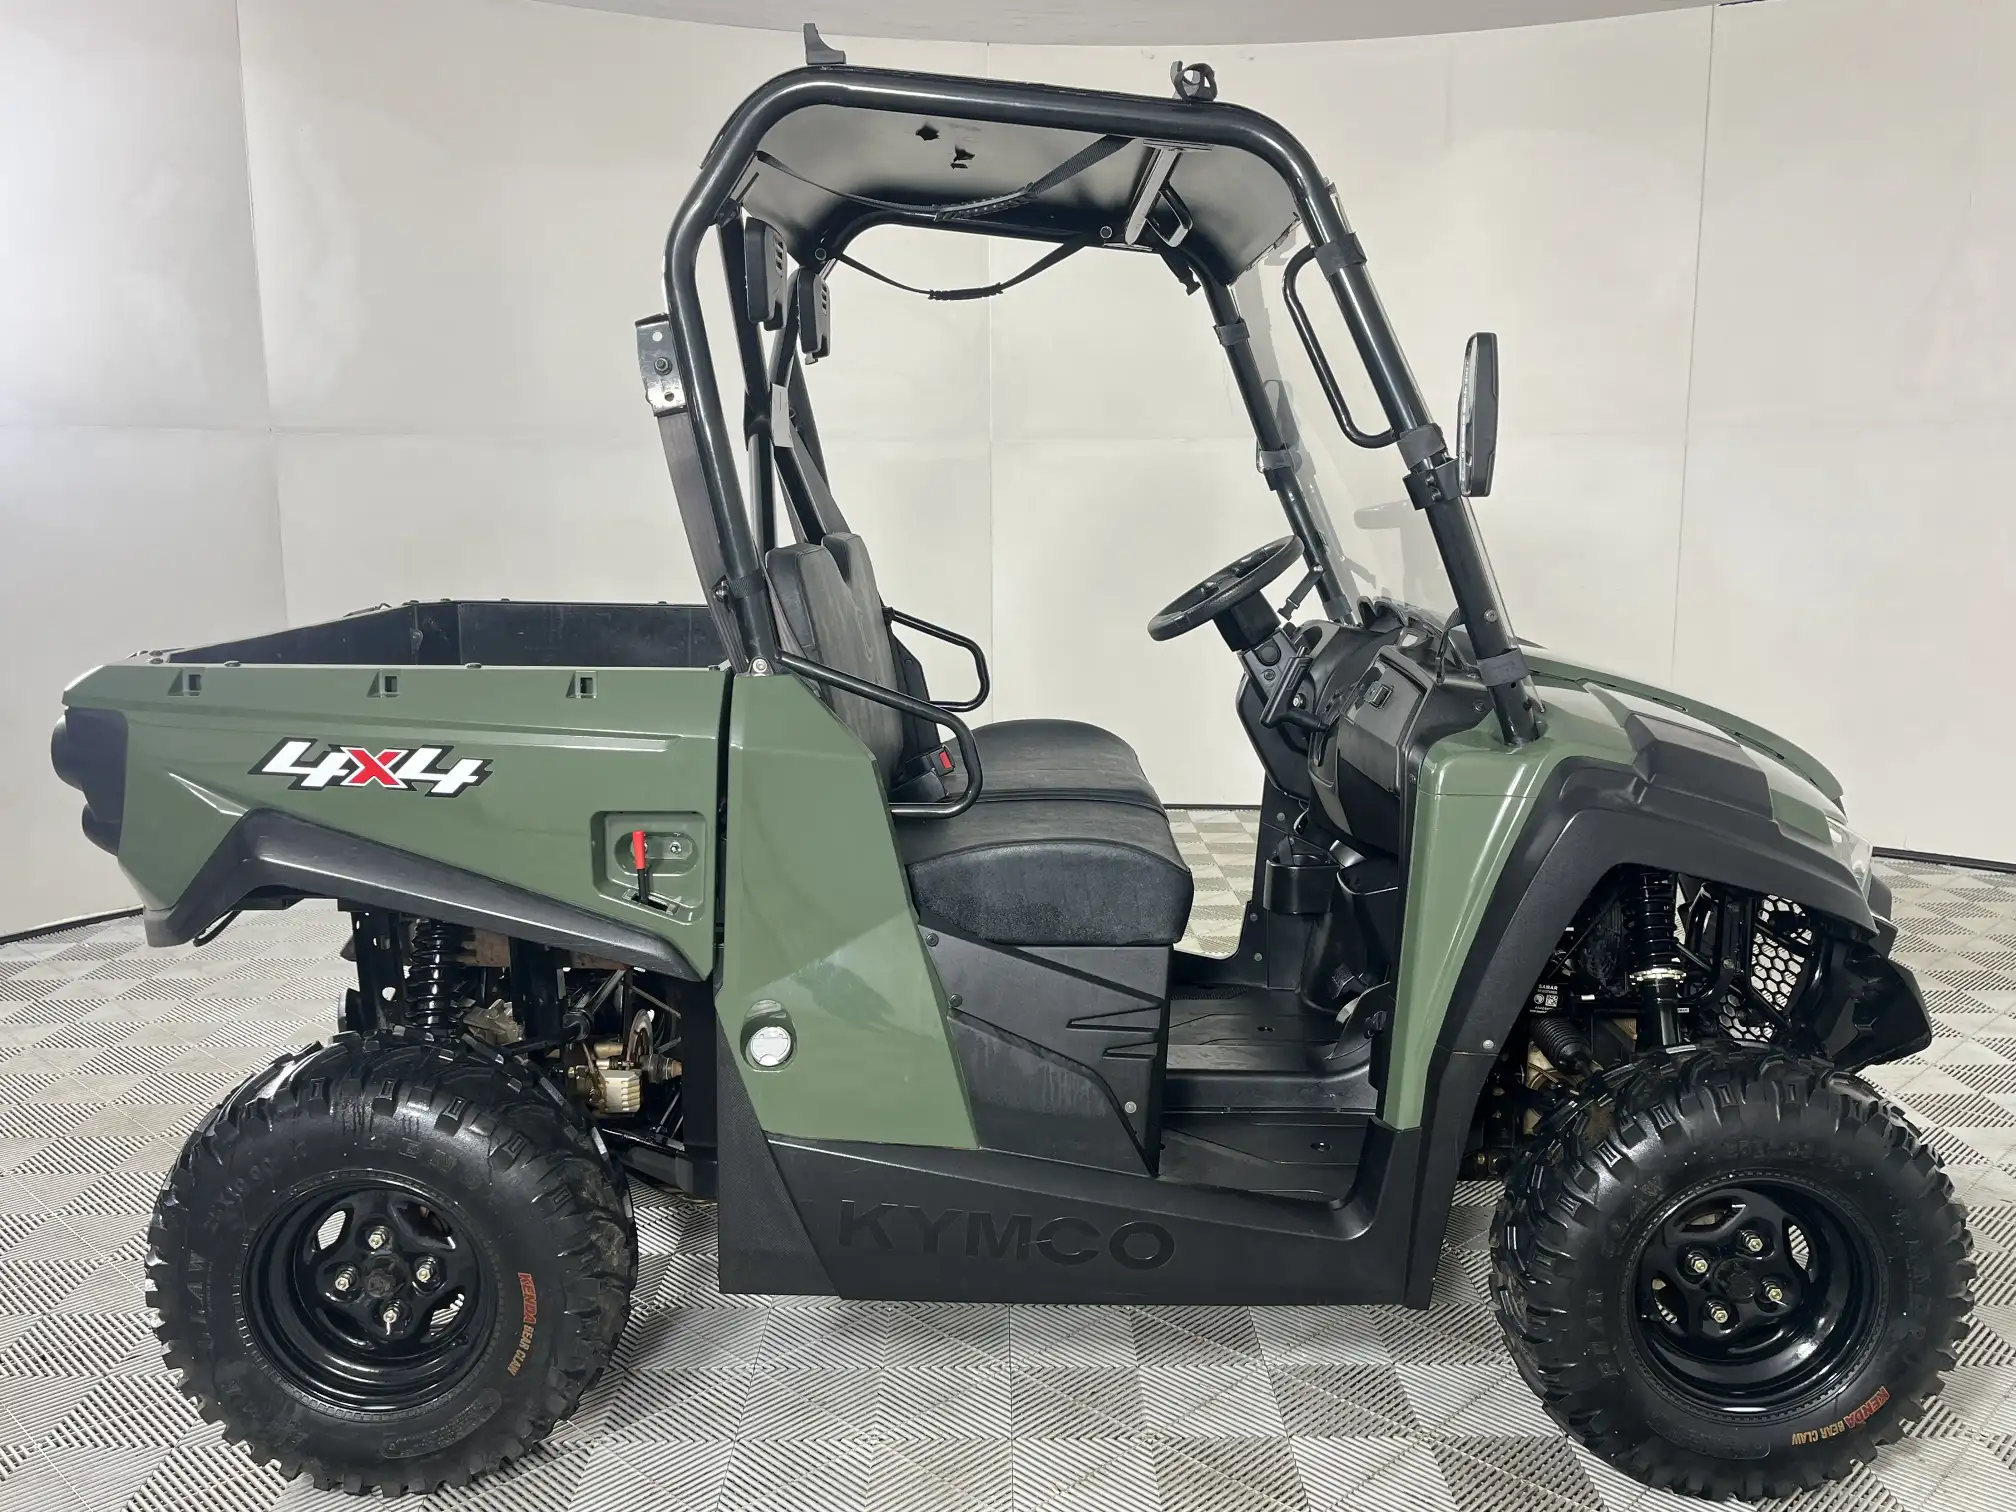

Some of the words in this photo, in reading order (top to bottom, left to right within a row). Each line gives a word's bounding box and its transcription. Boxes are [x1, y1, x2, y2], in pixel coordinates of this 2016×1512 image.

[838, 1199, 1176, 1271] KYMCO
[517, 1272, 538, 1325] KENDA
[519, 1324, 535, 1351] BEAR
[507, 1349, 526, 1376] CLAW
[1843, 1385, 1891, 1429] KENDA
[1791, 1430, 1819, 1446] CLAW
[1820, 1420, 1846, 1439] BEAR
